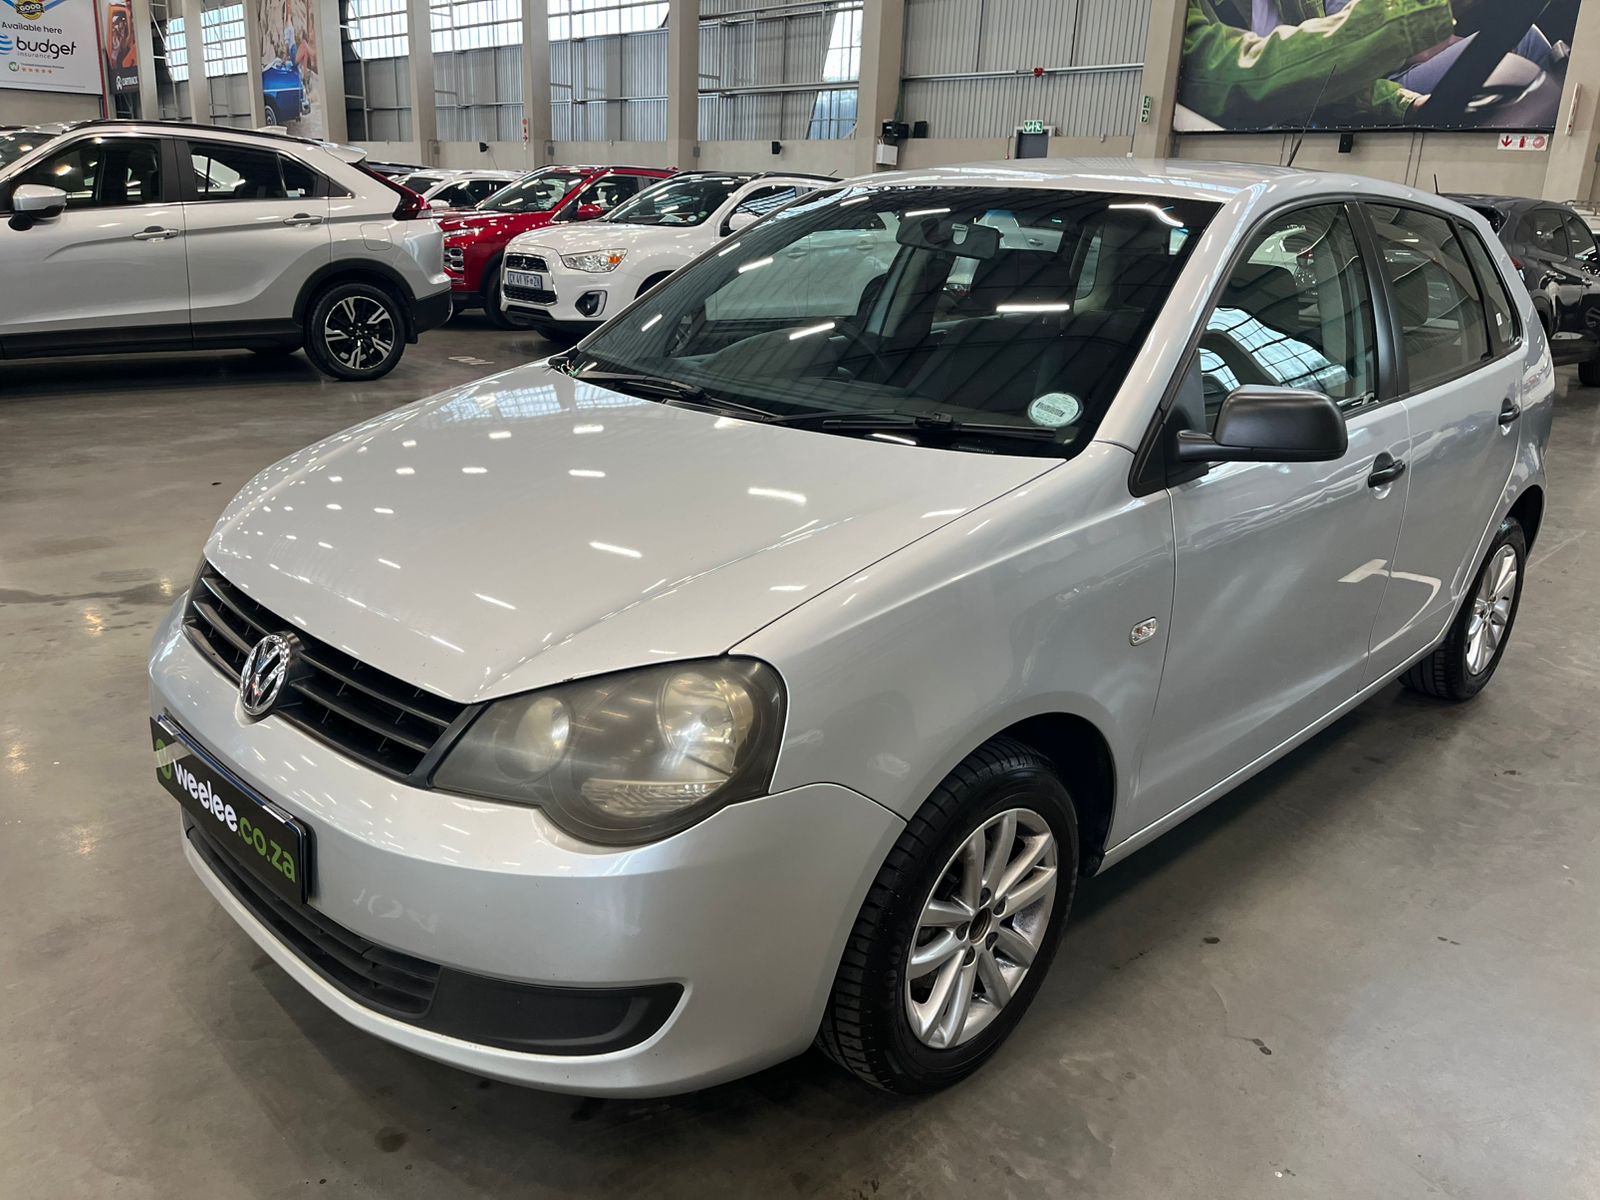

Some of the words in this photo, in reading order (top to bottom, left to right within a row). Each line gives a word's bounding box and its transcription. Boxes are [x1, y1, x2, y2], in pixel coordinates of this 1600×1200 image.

[2, 21, 41, 32] Available
[43, 25, 62, 34] here
[16, 36, 76, 59] budget
[173, 759, 295, 882] weelee.co.za
